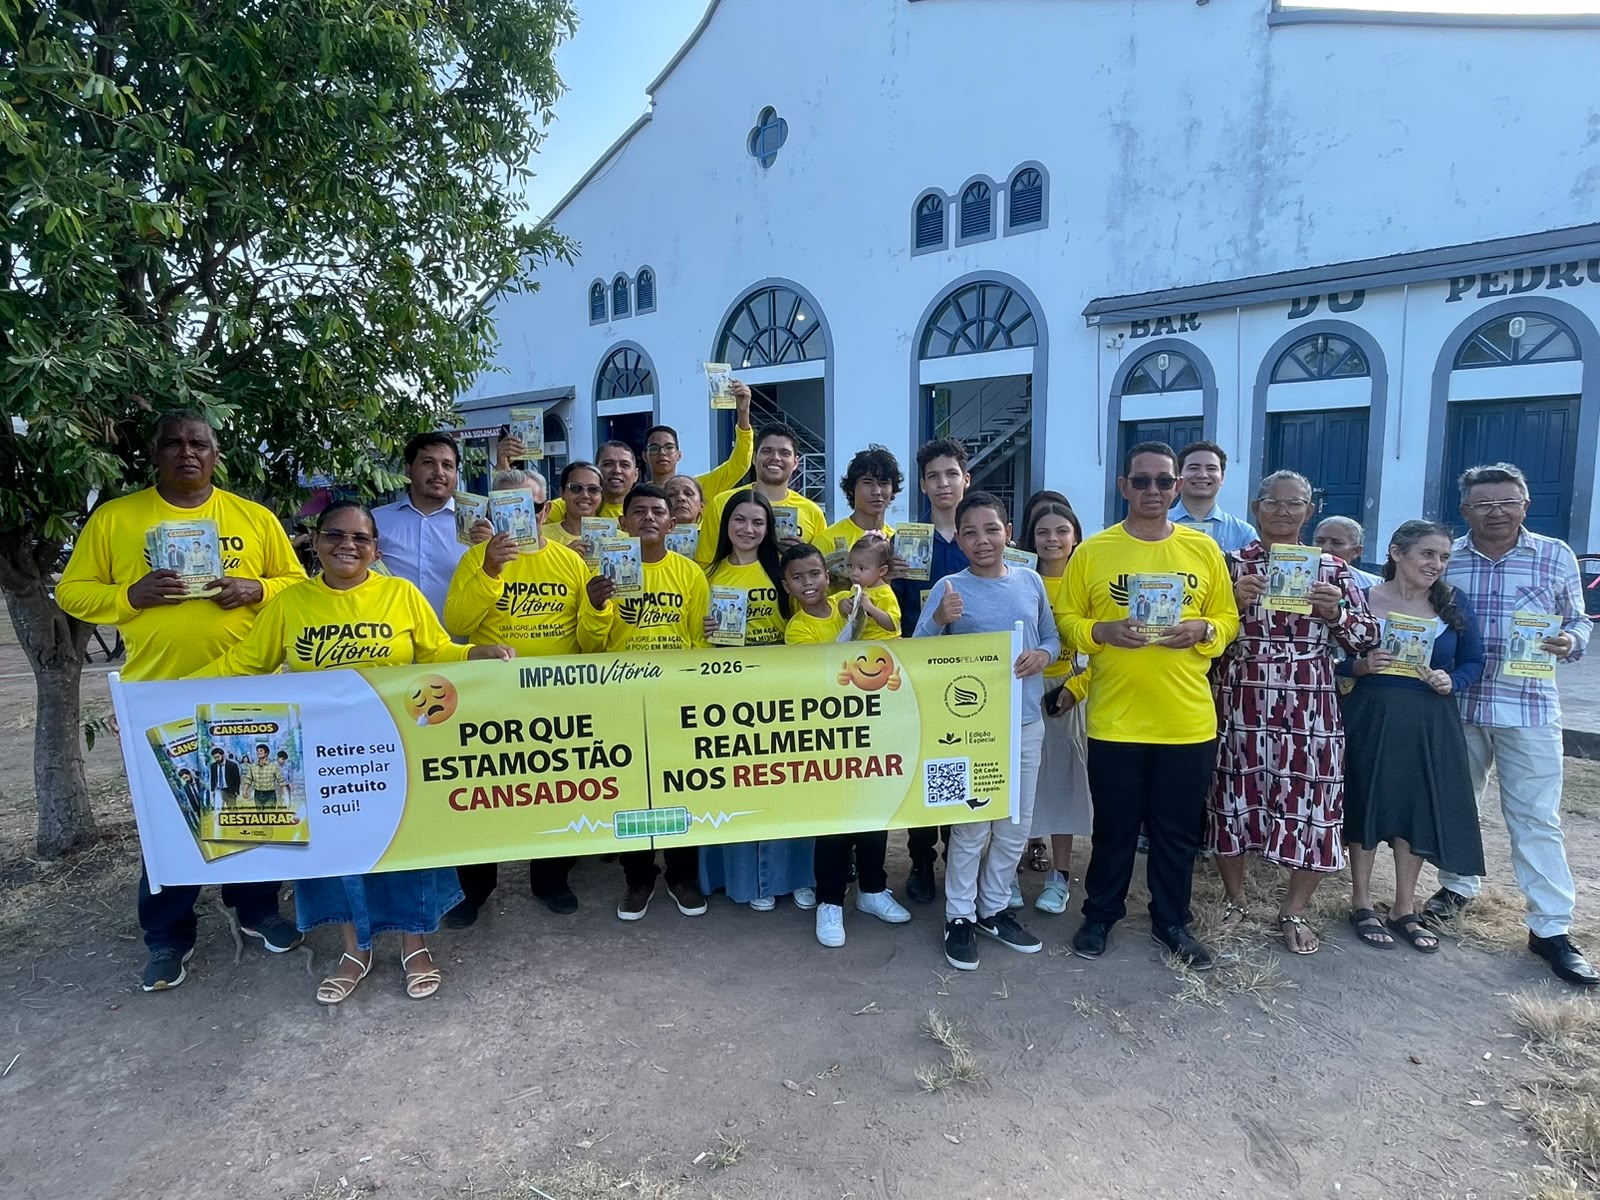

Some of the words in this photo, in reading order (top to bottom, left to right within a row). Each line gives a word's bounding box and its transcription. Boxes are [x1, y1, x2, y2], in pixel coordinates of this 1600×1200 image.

[1129, 312, 1202, 339] BAR
[504, 582, 568, 596] MPACTO
[510, 595, 565, 616] Vitória
[625, 592, 684, 608] IMPACTO
[637, 607, 681, 628] Vitória
[303, 623, 393, 641] IMPACTO
[314, 639, 393, 667] Vitória
[927, 655, 999, 665] #TODOSPELAVIDA
[519, 663, 598, 689] IMPACTO
[599, 659, 664, 686] Vitória
[700, 660, 743, 676] 2026
[680, 705, 698, 729] E
[703, 703, 726, 727] O
[732, 699, 795, 728] QUE
[801, 694, 882, 721] PODE
[213, 724, 274, 735] CANSADOS
[459, 718, 525, 747] POR
[528, 714, 594, 744] QUE
[171, 741, 199, 756] CANS
[694, 725, 871, 760] REALMENTE
[969, 736, 996, 744] Especial
[316, 743, 365, 758] Retire
[369, 743, 395, 754] seu
[318, 760, 390, 777] exemplar
[422, 748, 569, 782] ESTAMOS
[572, 739, 633, 770] TÃO
[663, 766, 726, 793] NOS
[733, 753, 903, 788] RESTAURAR
[320, 780, 387, 799] gratuito
[448, 777, 620, 811] CANSADOS
[322, 800, 360, 816] aqui!
[219, 813, 296, 824] RESTAURAR
